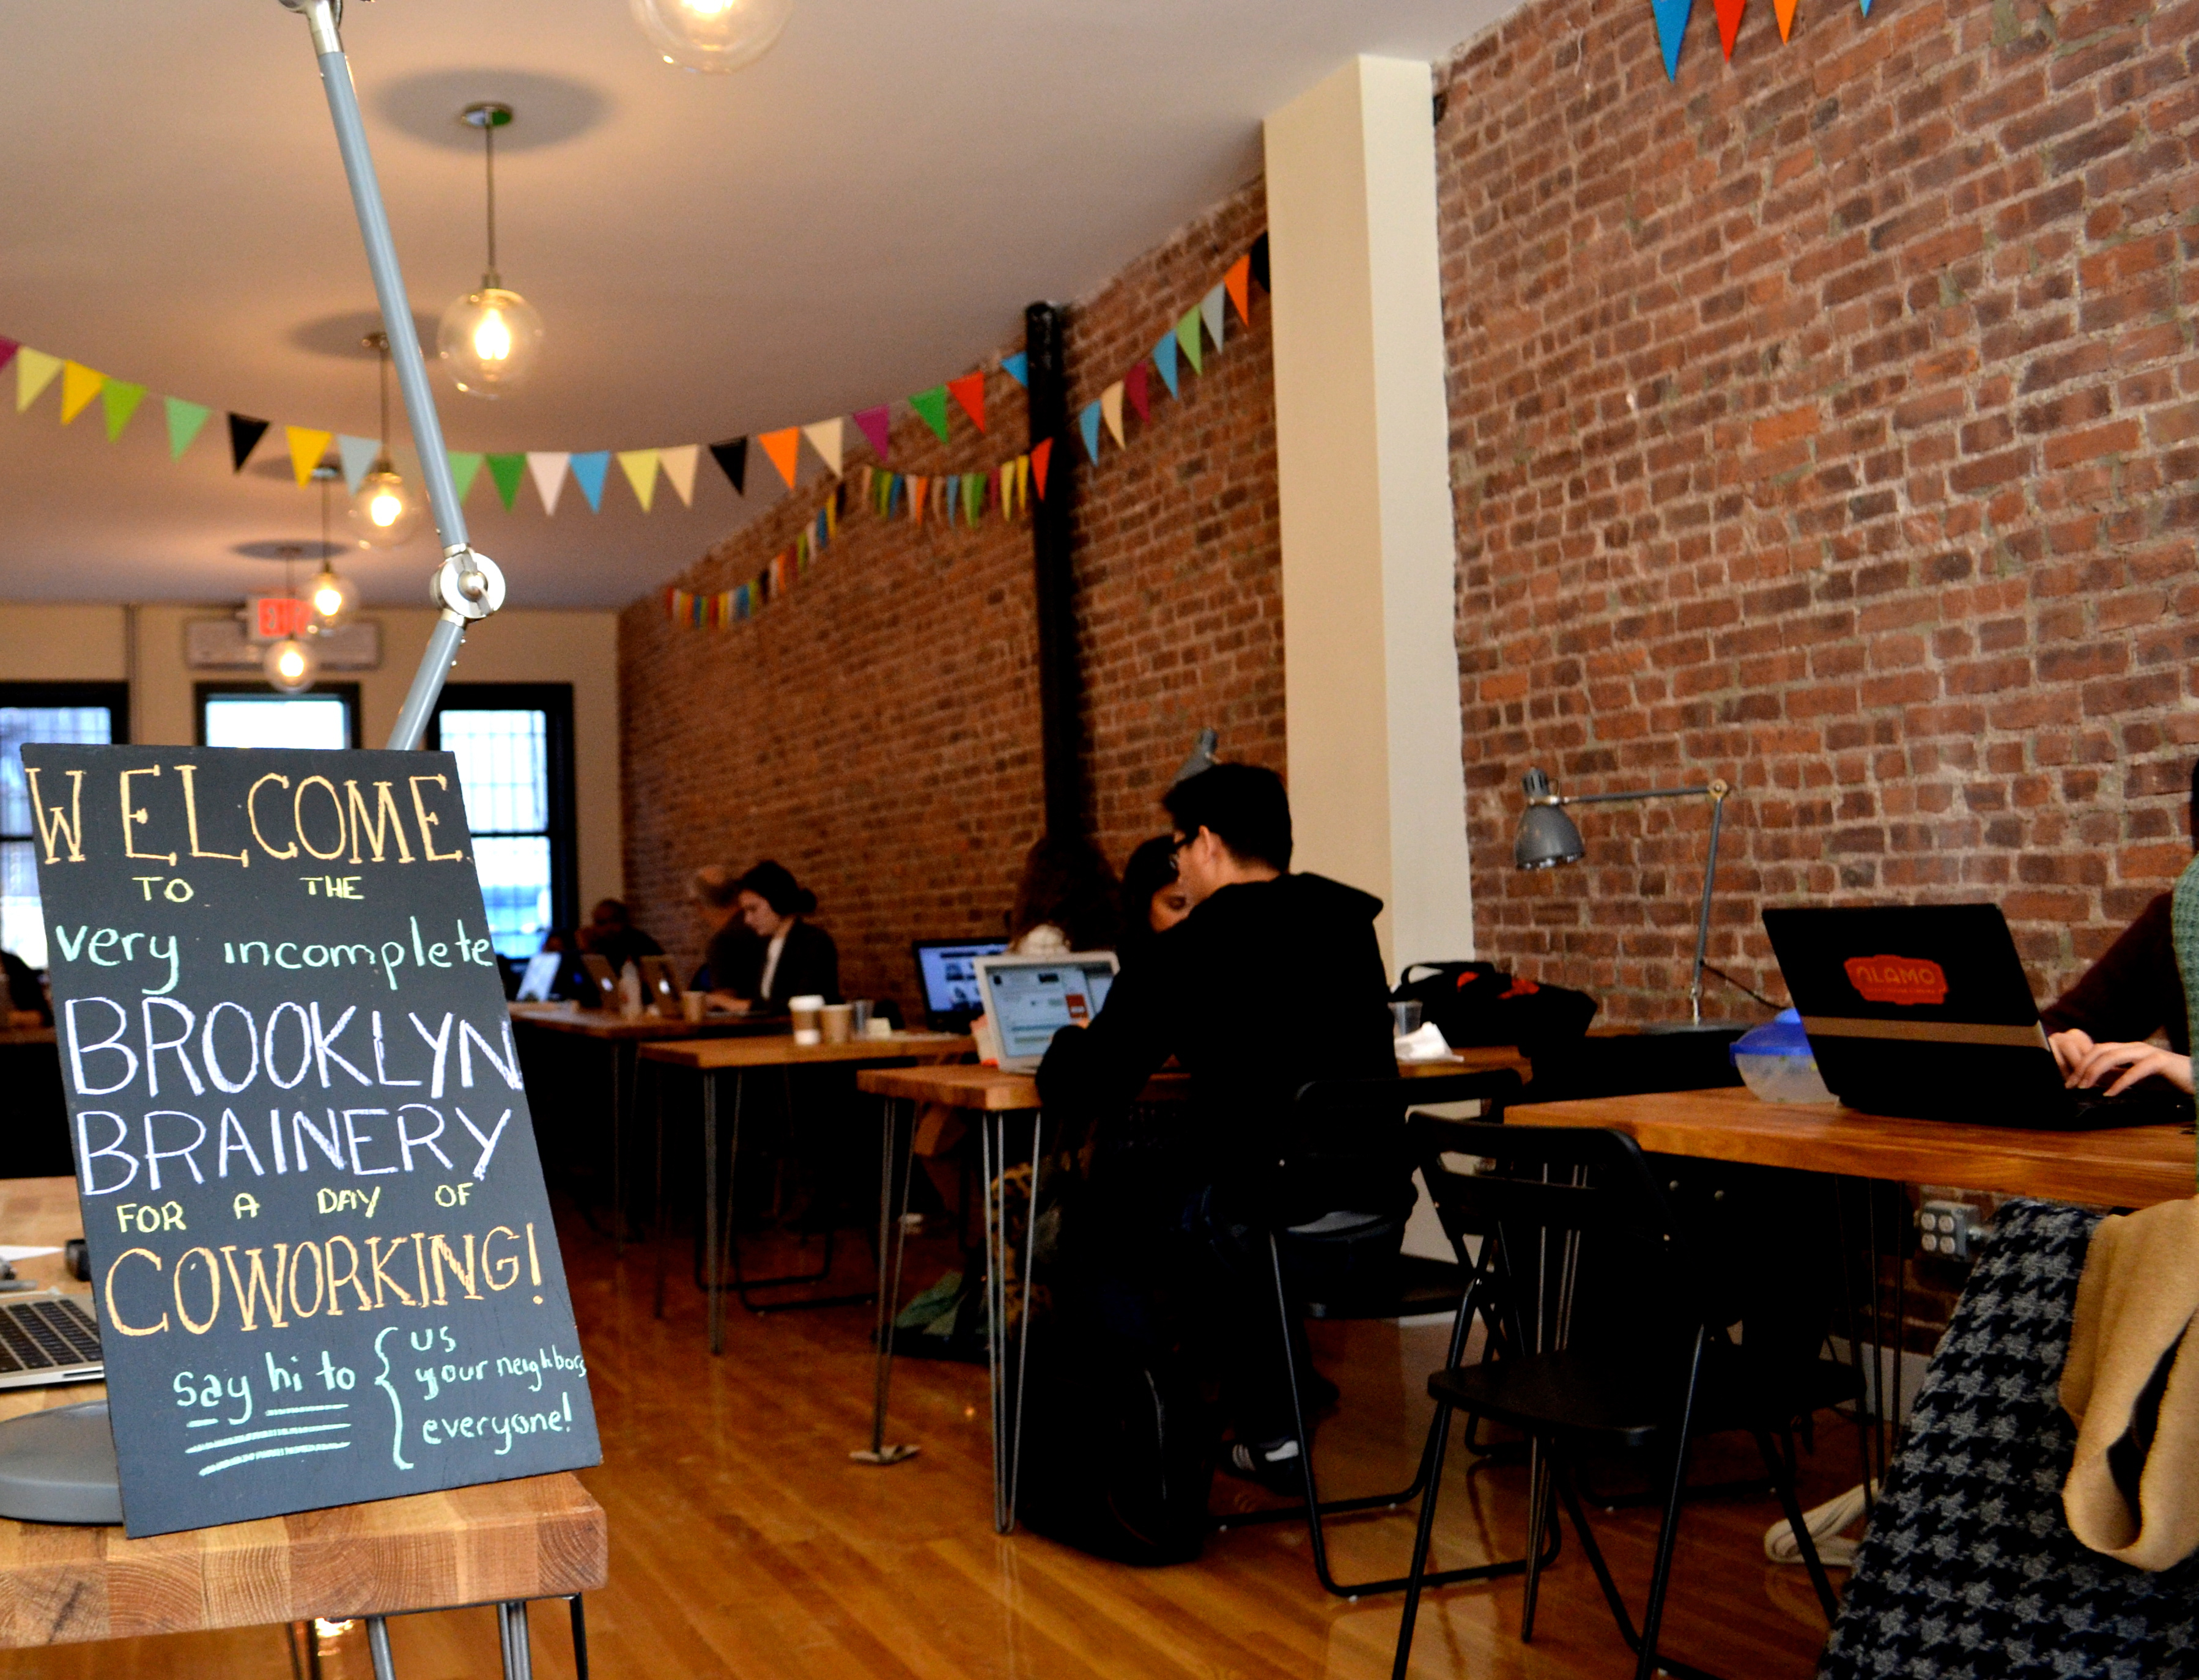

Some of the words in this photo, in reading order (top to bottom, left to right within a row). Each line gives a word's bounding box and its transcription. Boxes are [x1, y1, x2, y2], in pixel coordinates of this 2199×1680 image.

[24, 764, 464, 866] WELCOME
[132, 876, 194, 902] TO
[299, 875, 365, 900] THE
[55, 925, 179, 995] very
[224, 916, 493, 990] incomplete
[1855, 965, 1936, 986] ALAMO
[65, 996, 525, 1099] BROOKLYN
[76, 1103, 512, 1195] BRAINERY
[116, 1201, 187, 1233] FOR
[233, 1192, 261, 1220] A
[316, 1186, 381, 1219] DAY
[434, 1182, 475, 1208] OF
[105, 1223, 543, 1336] COWORKING!
[410, 1324, 457, 1352] us
[173, 1371, 253, 1422] say
[265, 1350, 303, 1393] hi
[315, 1350, 357, 1392] to
[415, 1357, 489, 1401] your
[496, 1344, 588, 1393] neighbors
[421, 1391, 574, 1456] everyone!
